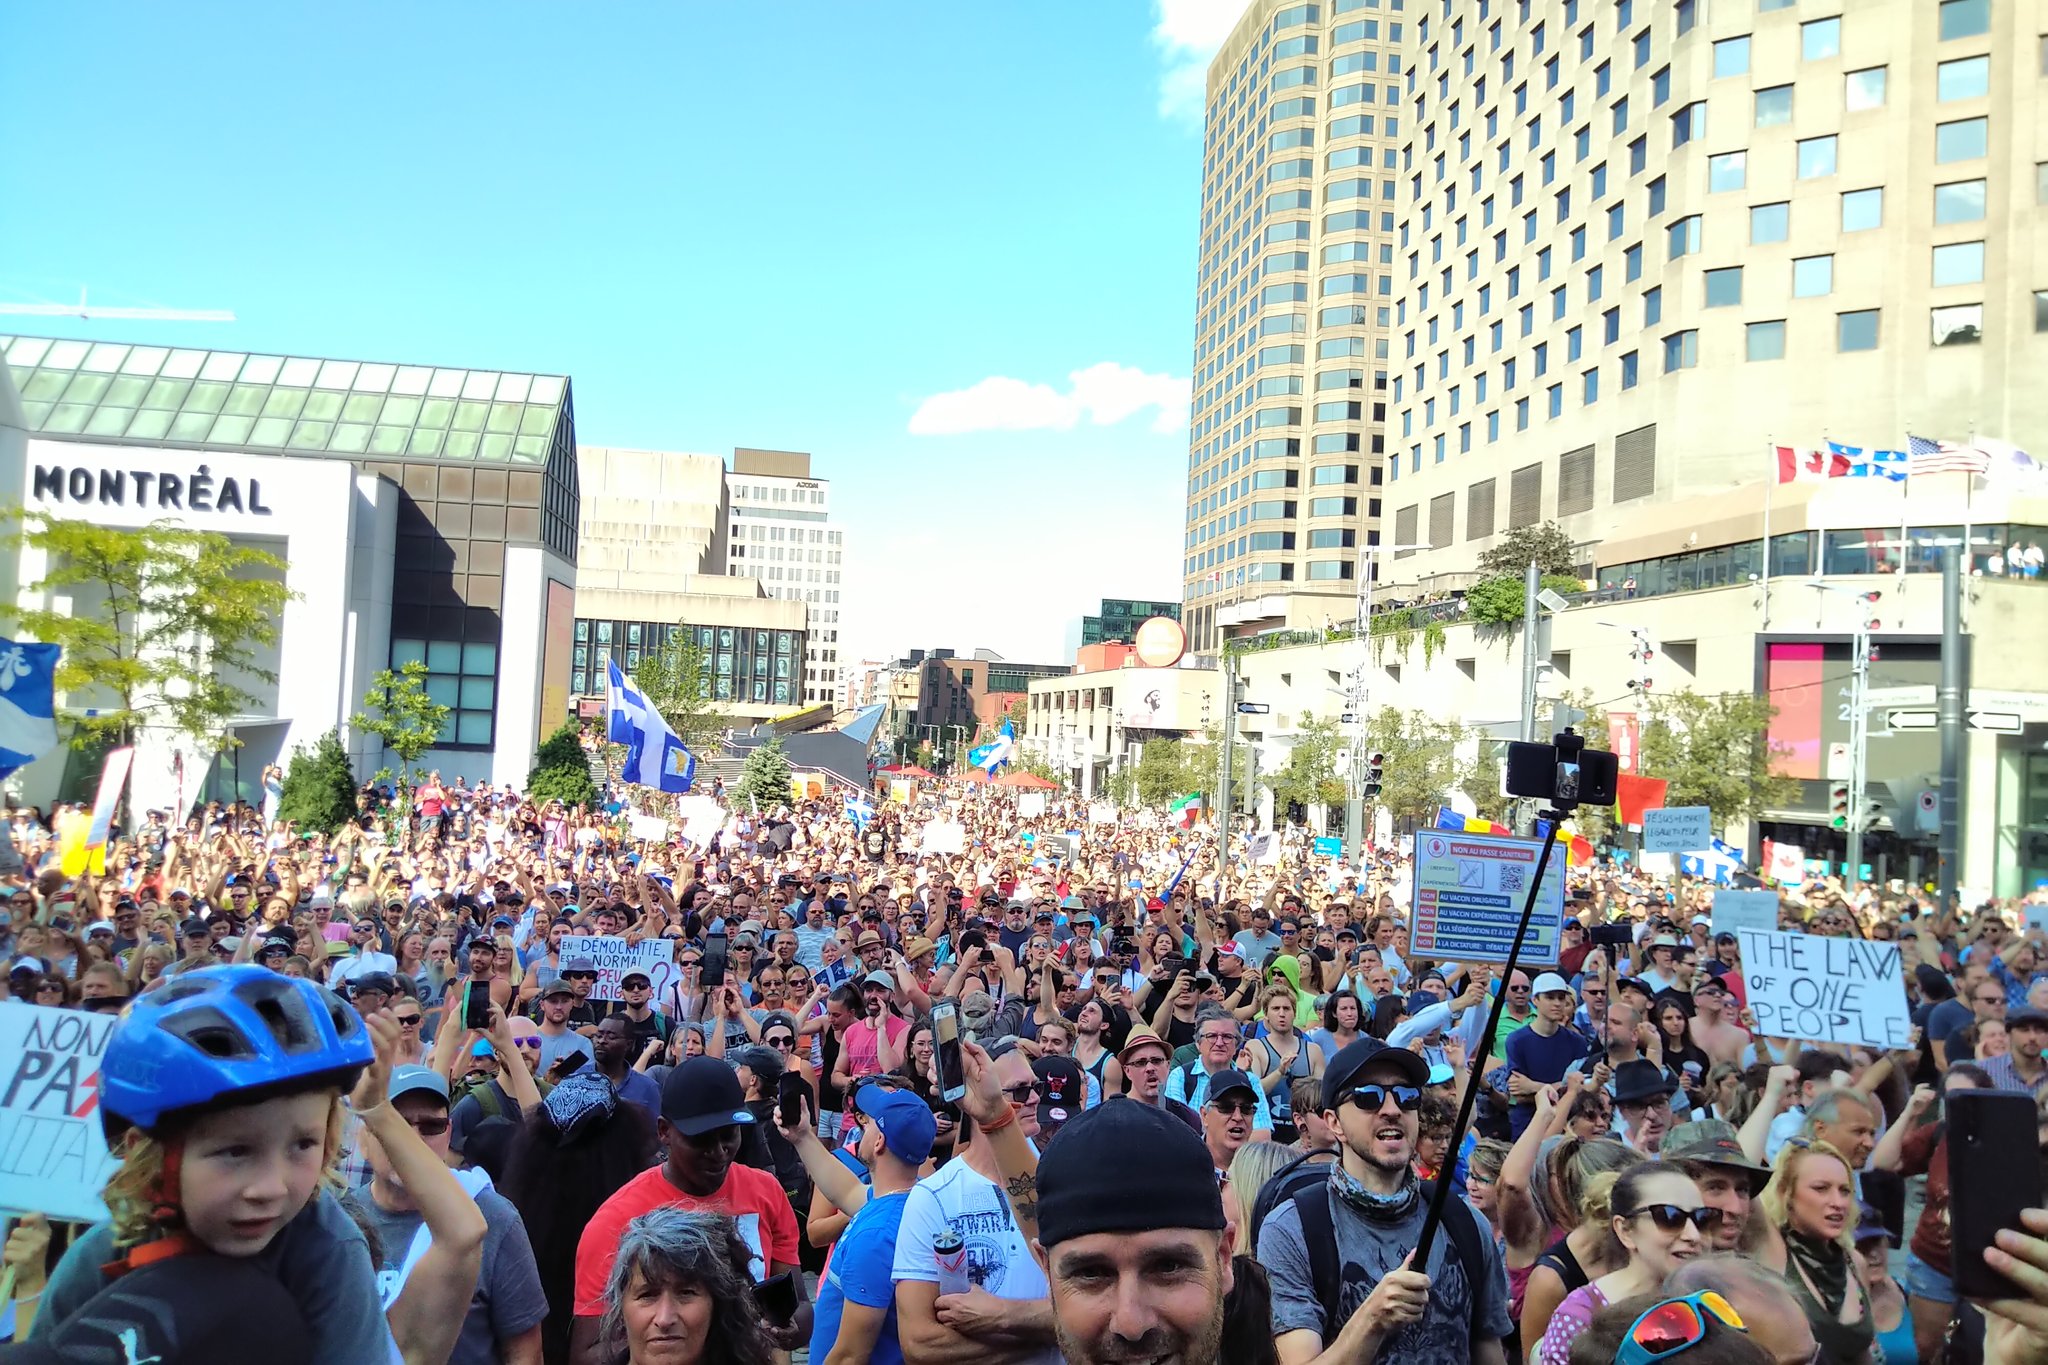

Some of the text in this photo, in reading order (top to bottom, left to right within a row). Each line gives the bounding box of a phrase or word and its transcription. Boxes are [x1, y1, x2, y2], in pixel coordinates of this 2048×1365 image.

[33, 464, 272, 516] MONTRÉAL
[1452, 846, 1468, 854] NON
[1469, 847, 1479, 855] AU
[1480, 848, 1499, 857] PASSE
[1499, 850, 1531, 860] SANITAIRE
[1421, 892, 1435, 900] NON
[1450, 894, 1470, 903] VACCIN
[1471, 896, 1507, 906] OBLIGATOIRE
[1420, 907, 1434, 915] NON
[1449, 909, 1470, 918] VACCIN
[562, 941, 573, 950] EN
[1486, 943, 1504, 951] DÉBAT
[1740, 931, 1901, 981] THE LAW
[1751, 975, 1865, 1013] OF ONE
[22, 1014, 115, 1057] NON
[1750, 1002, 1910, 1048] PEOPLE
